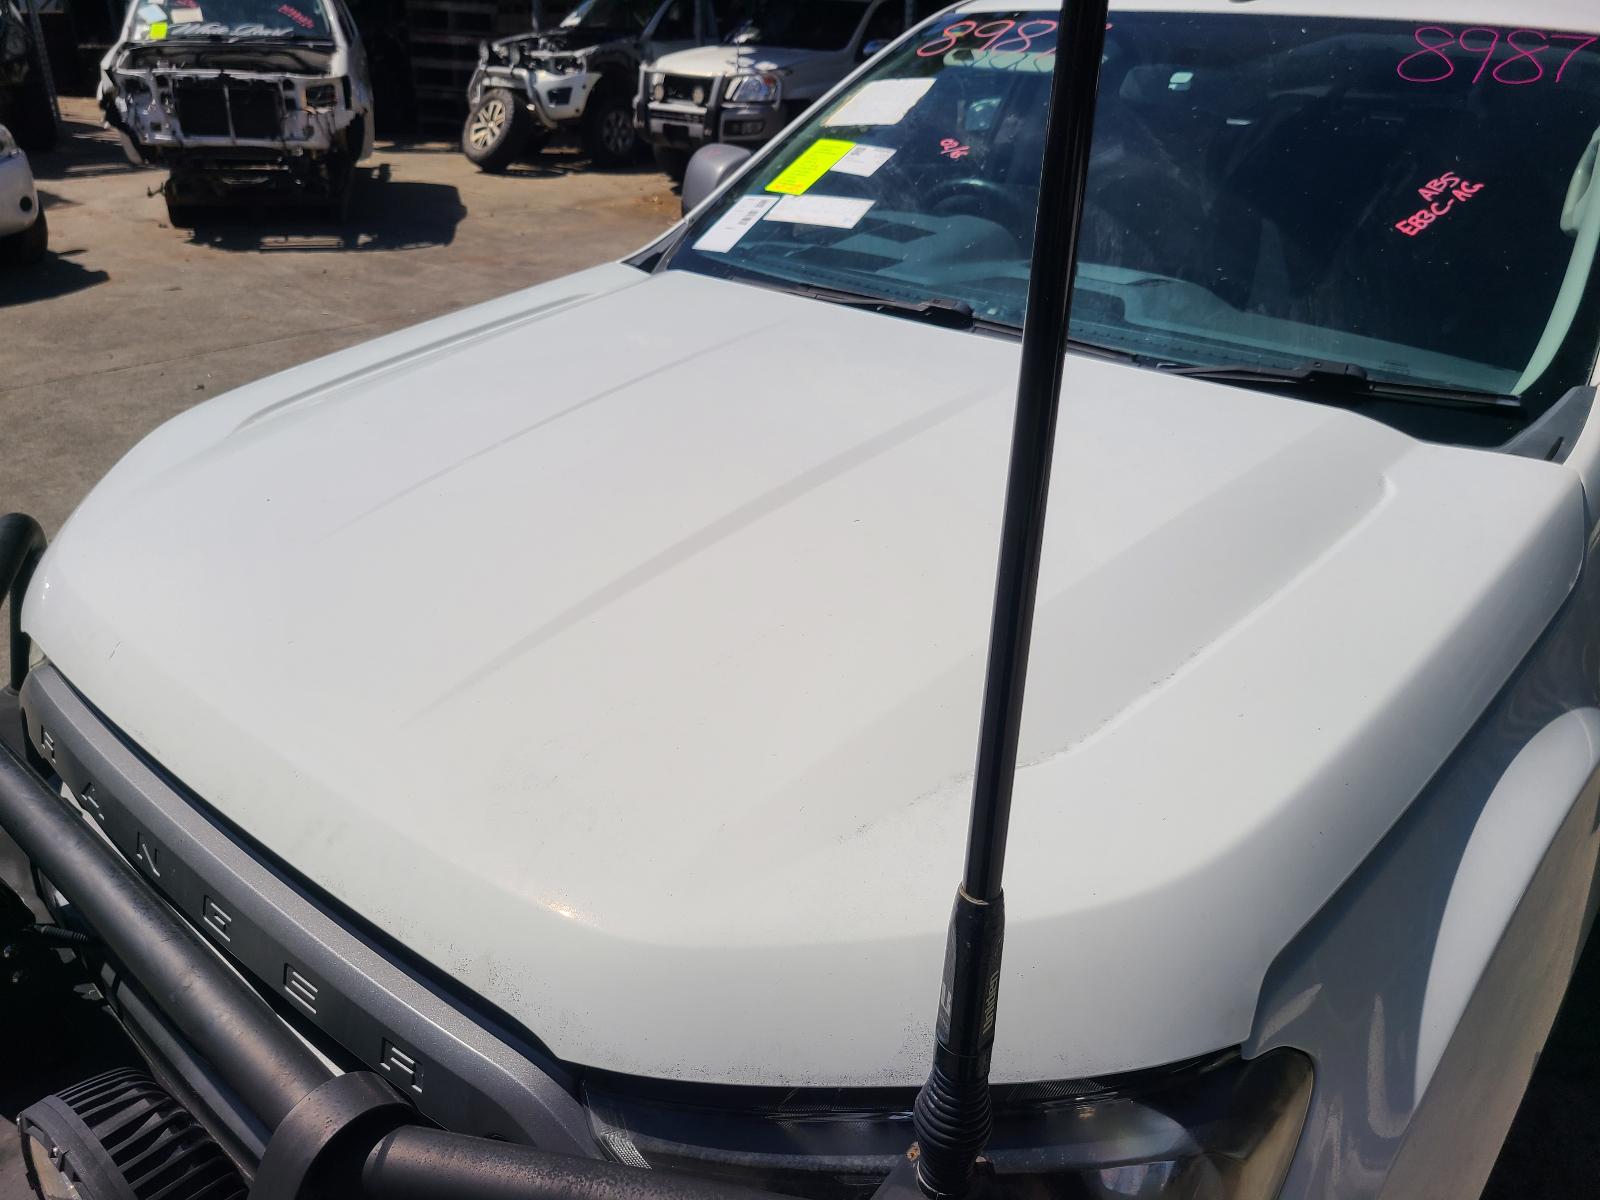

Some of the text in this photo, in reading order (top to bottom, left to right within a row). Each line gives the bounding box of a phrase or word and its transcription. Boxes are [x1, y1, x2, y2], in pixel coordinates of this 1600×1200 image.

[917, 20, 1113, 59] 898
[1397, 26, 1599, 84] 8987
[1418, 171, 1460, 202] ABS
[41, 724, 424, 1094] RANGER
